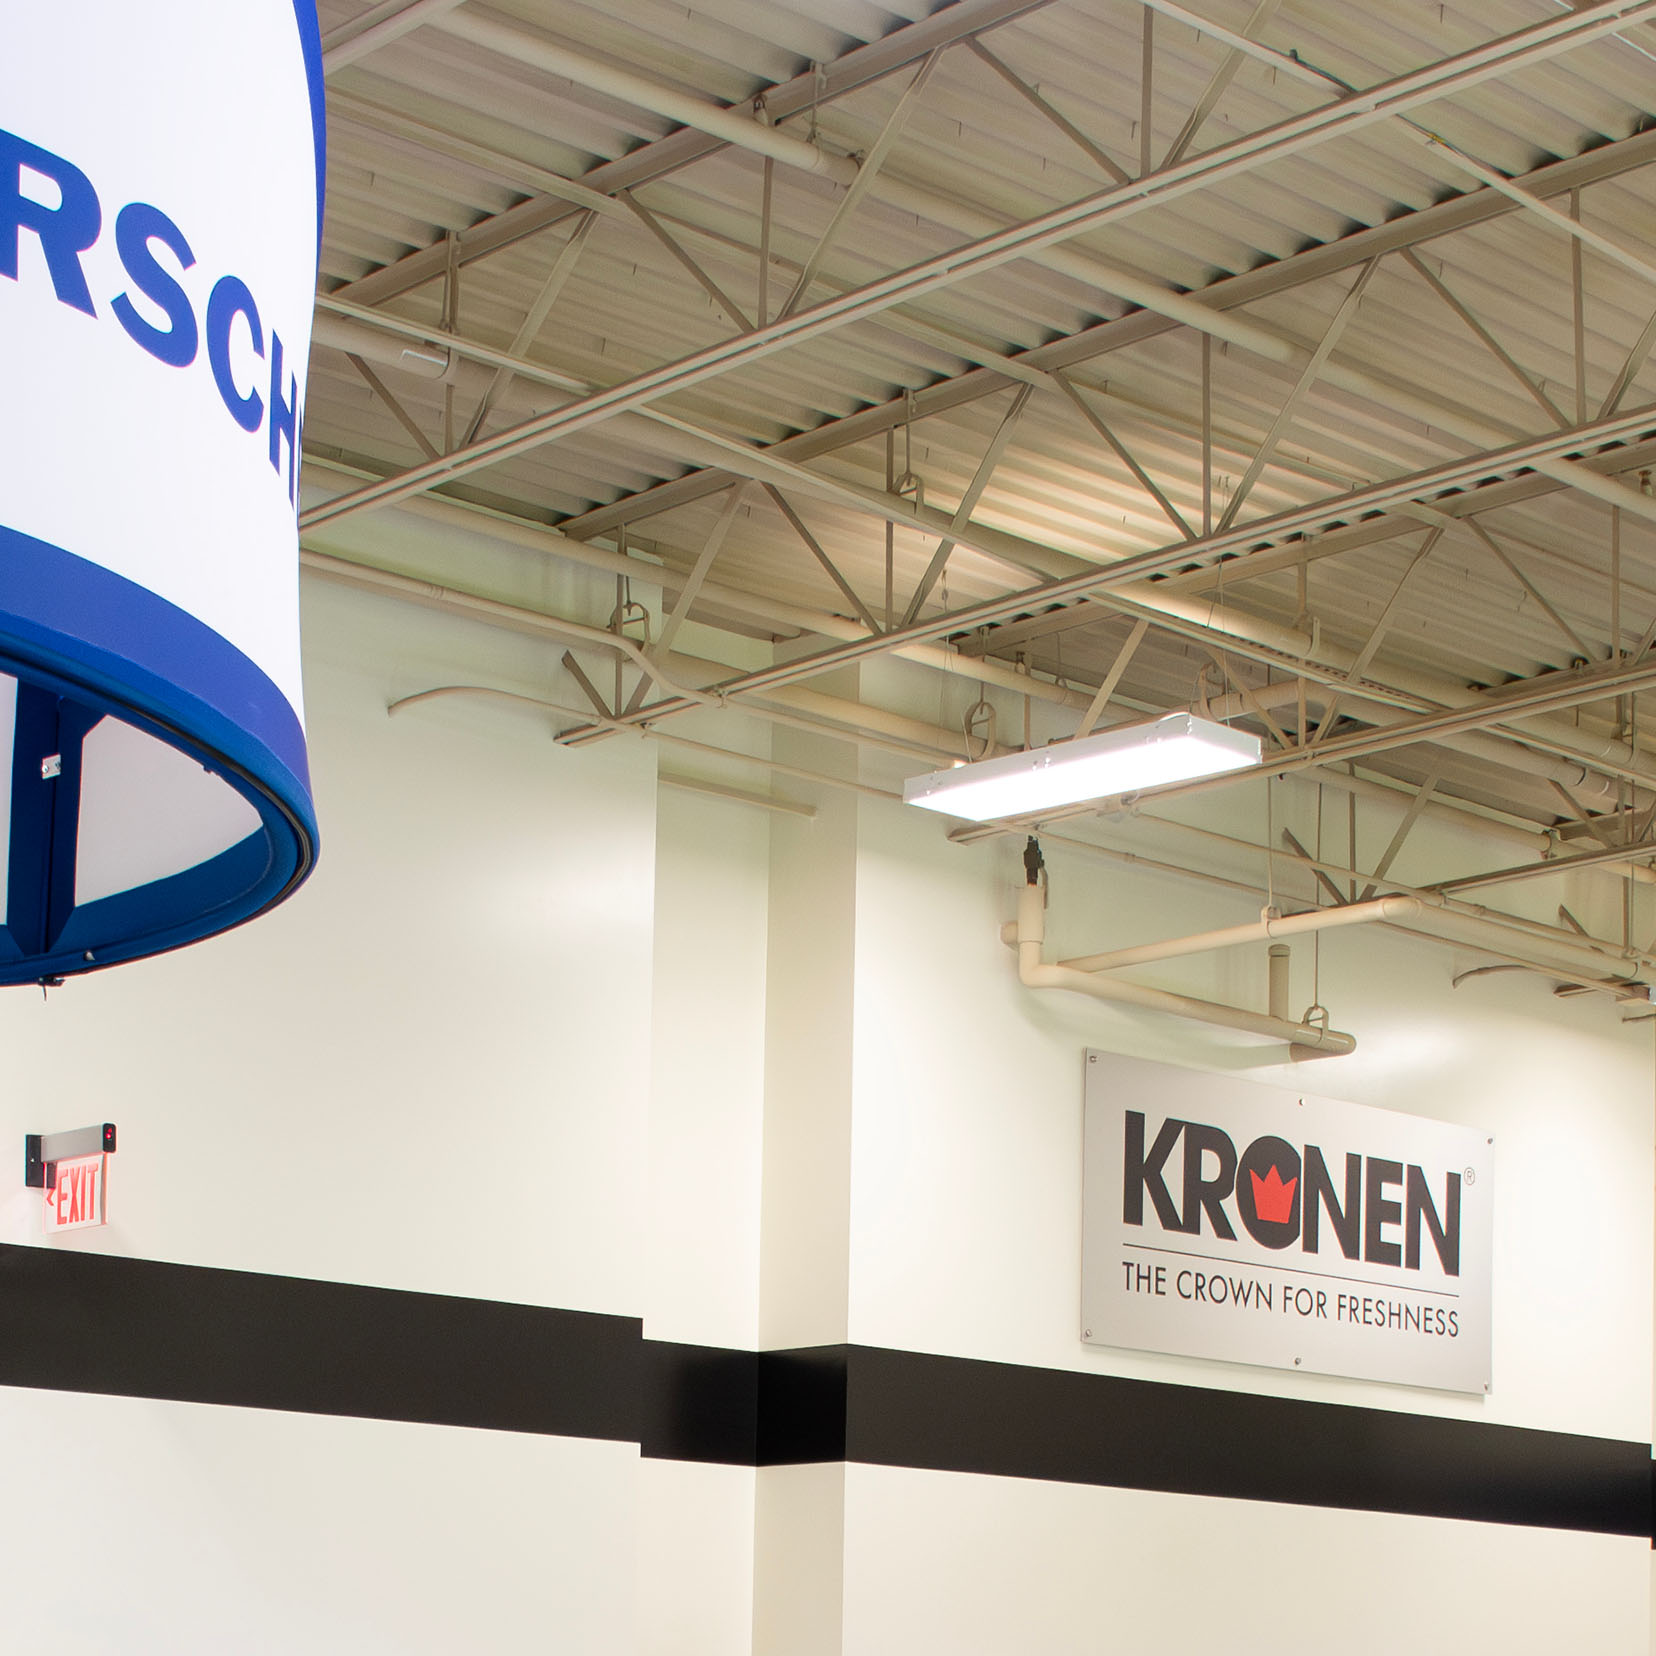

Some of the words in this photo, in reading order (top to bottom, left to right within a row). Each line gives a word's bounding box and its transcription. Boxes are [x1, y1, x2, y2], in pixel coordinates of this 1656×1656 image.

[55, 1162, 100, 1227] EXIT
[1121, 1260, 1166, 1297] THE
[1176, 1269, 1273, 1314] CROWN
[1283, 1286, 1327, 1319] FOR
[1337, 1294, 1460, 1339] FRESHNESS
